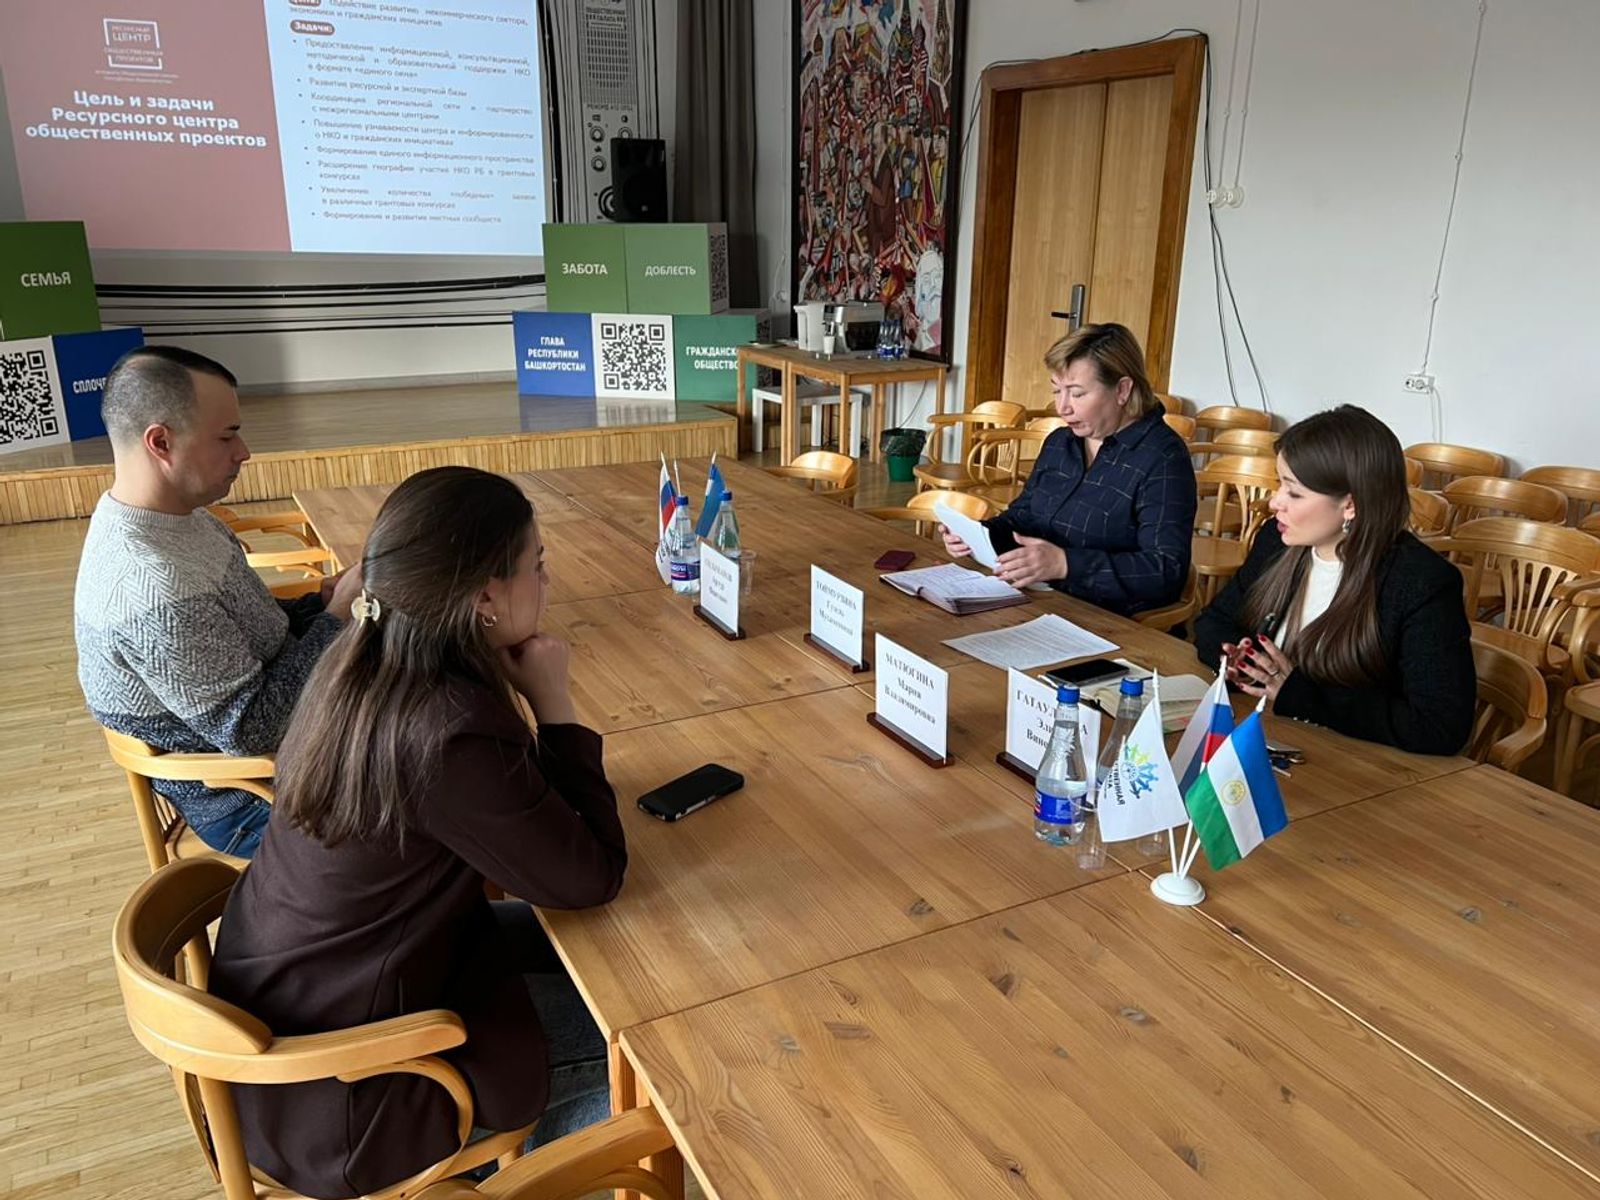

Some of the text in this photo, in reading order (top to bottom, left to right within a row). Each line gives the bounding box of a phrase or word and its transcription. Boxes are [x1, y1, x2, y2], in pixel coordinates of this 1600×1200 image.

[112, 32, 152, 42] ЦЕНТР
[74, 90, 214, 111] Цель и задачи
[52, 107, 239, 130] Ресурсного центра
[26, 124, 266, 147] общественных проектов
[562, 262, 609, 276] ЗАБОТА
[645, 264, 697, 278] ДОБЛЕСТЬ
[20, 271, 72, 288] СЕМЬЯ
[540, 336, 566, 347] ГЛАВА
[527, 347, 580, 360] РЕСПУБЛИКИ
[524, 360, 587, 373] БАШКОРТОСТАН
